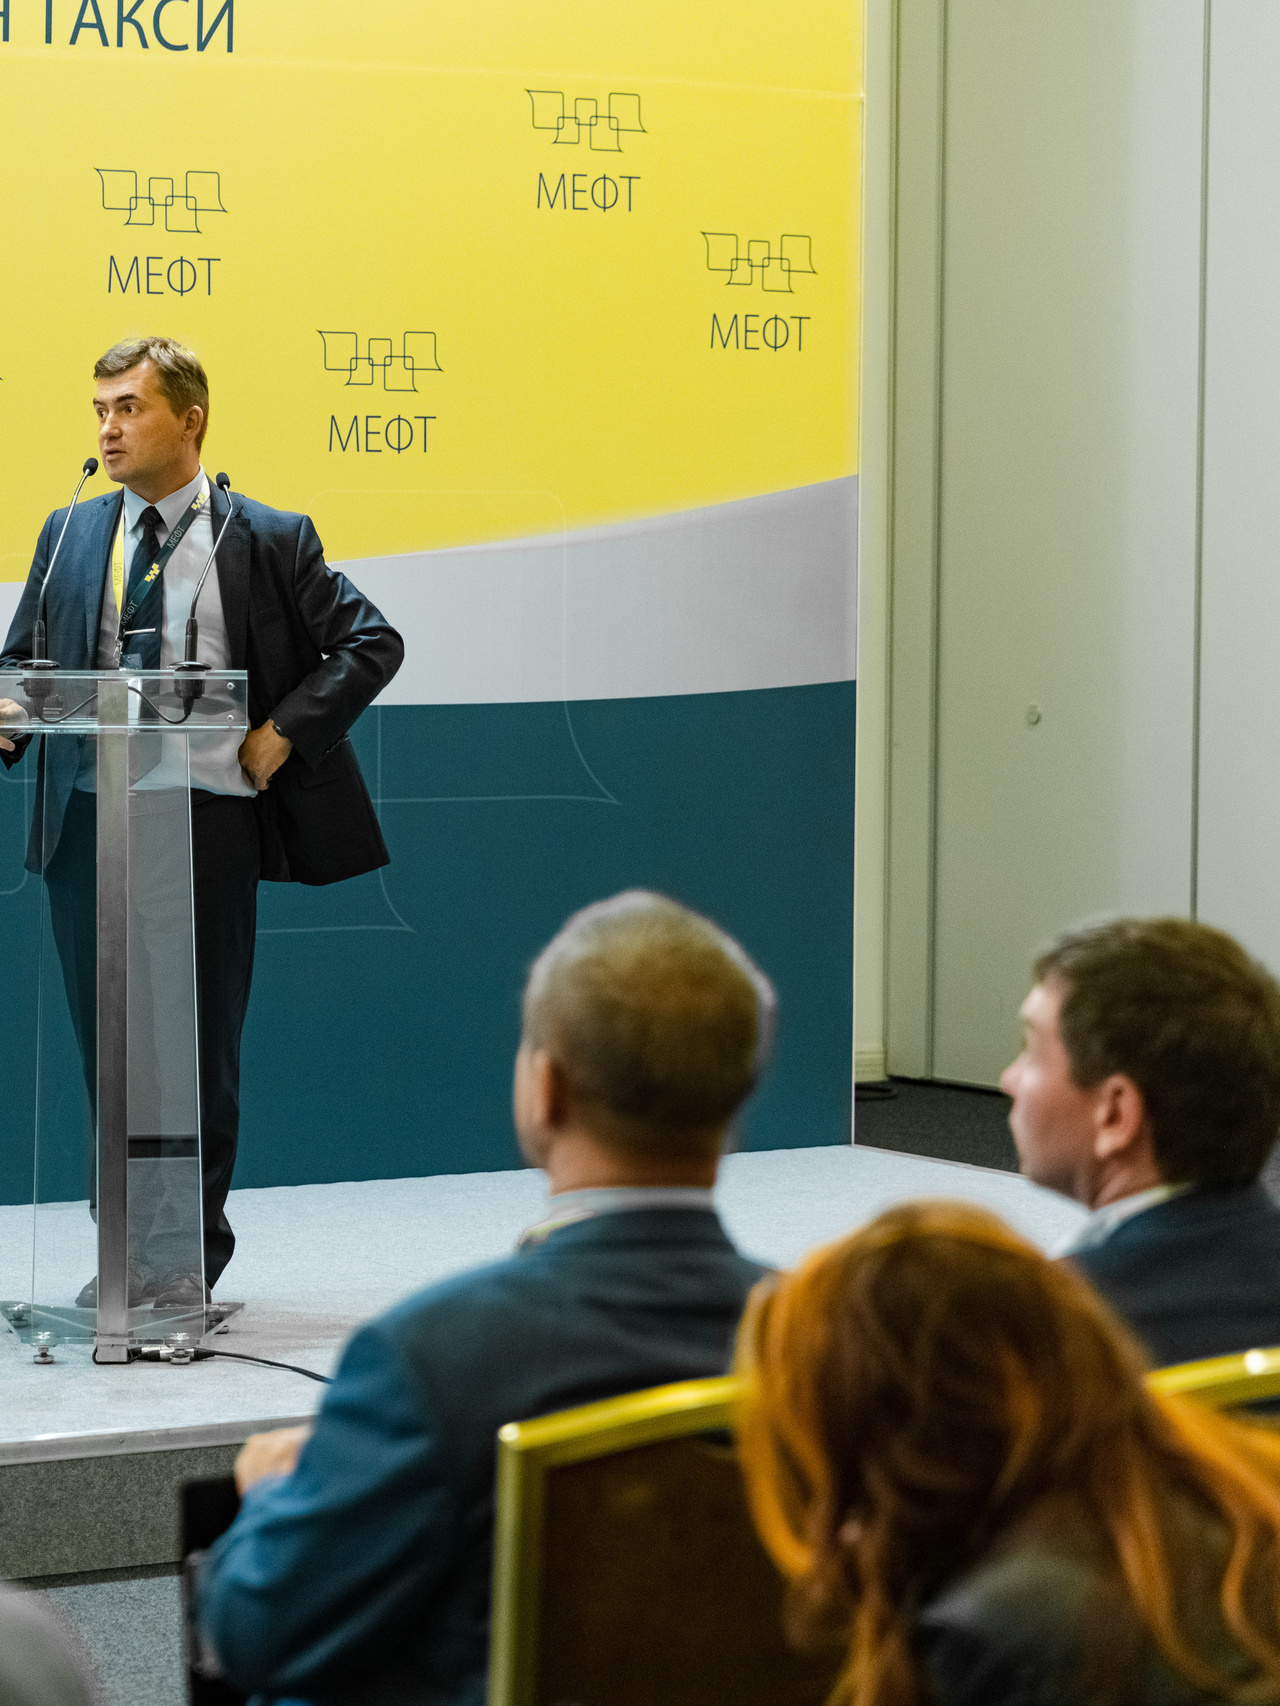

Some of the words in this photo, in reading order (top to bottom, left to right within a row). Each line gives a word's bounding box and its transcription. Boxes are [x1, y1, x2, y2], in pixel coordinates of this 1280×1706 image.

[44, 0, 235, 54] ТАКСИ
[536, 172, 642, 213] МЕФТ
[107, 254, 222, 297] МЕФТ
[710, 312, 812, 353] МЕФТ
[328, 414, 437, 455] МЕФТ
[167, 525, 185, 548] МЕФТ
